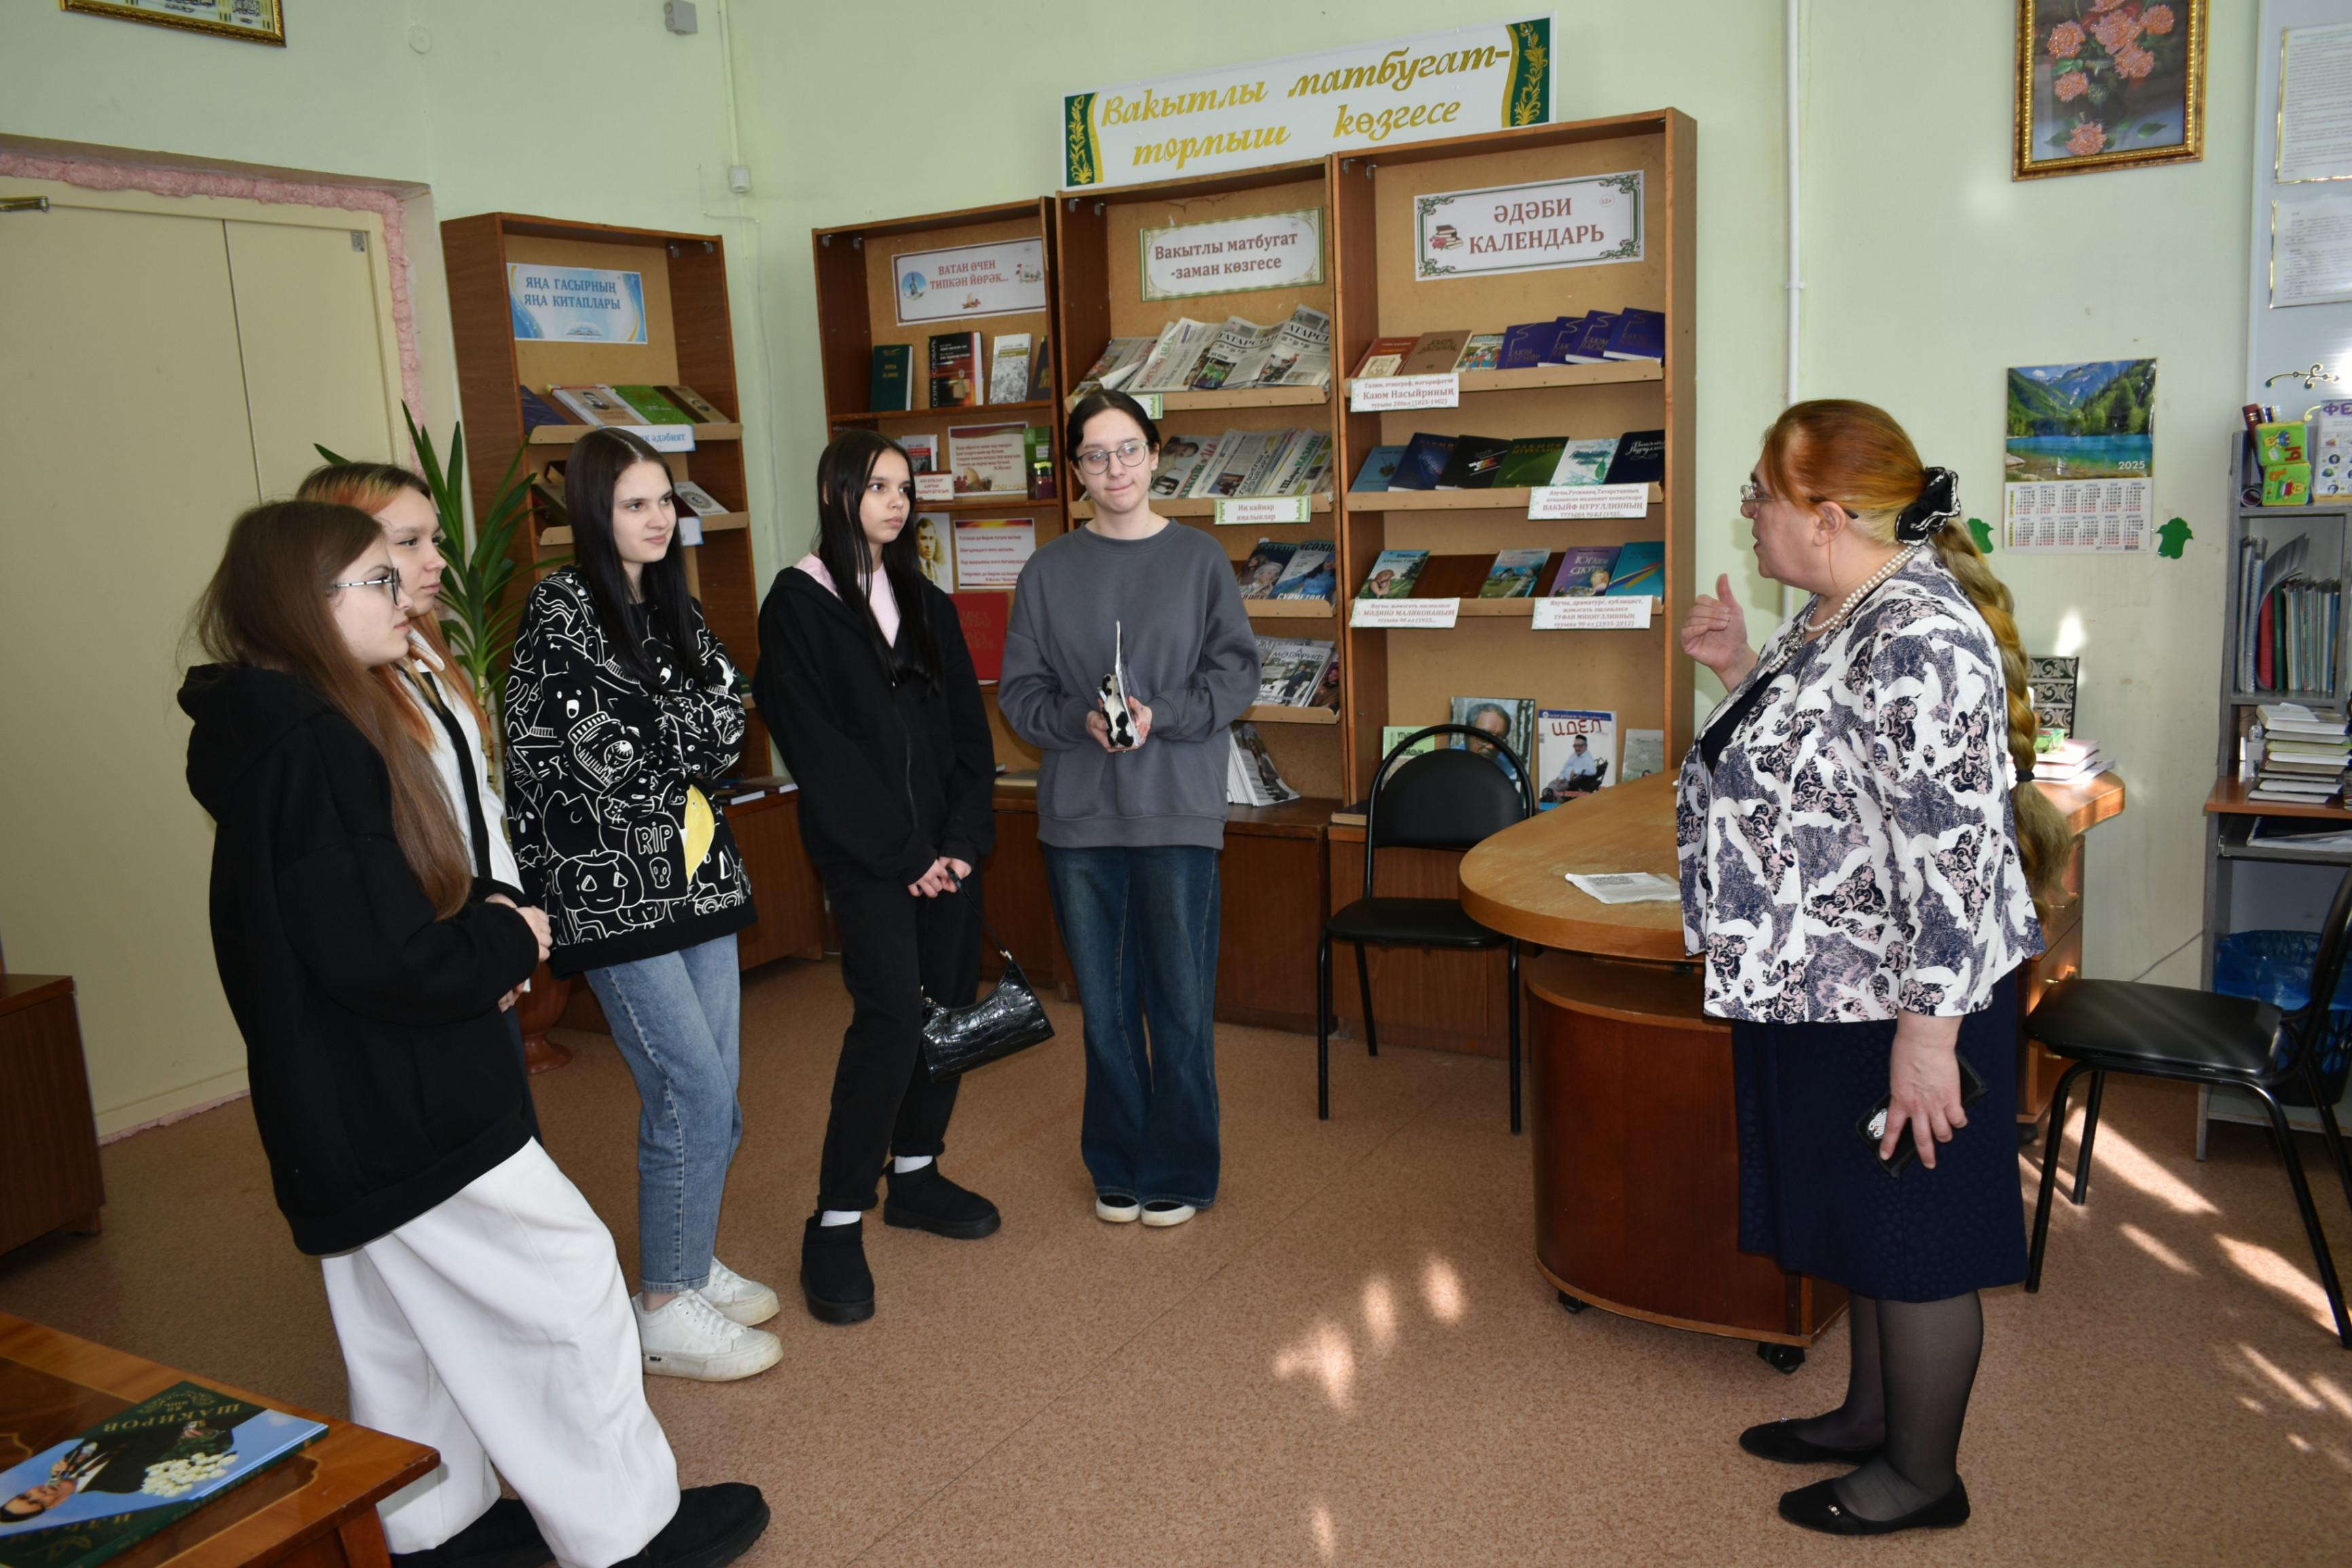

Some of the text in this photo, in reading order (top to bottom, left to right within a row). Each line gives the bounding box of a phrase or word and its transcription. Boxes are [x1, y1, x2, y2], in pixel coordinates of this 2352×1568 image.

[1101, 44, 1510, 127] Вакытлы матбугат-
[1132, 99, 1461, 170] тормыш көзгесе
[1494, 197, 1573, 225] ӘДӘБИ
[1155, 232, 1298, 261] Вакытлы матбугат
[1469, 224, 1605, 255] КАЛЕНДАРЬ
[937, 259, 996, 276] ВАТАН ӨЧЕН
[1170, 256, 1282, 280] -заман көзгесе
[525, 276, 617, 295] ЯҢА ГАСЫРНЫҢ
[929, 277, 969, 290] ТИПКӘН
[524, 294, 621, 310] ЯҢА КИТАПЛАРЫ
[1363, 388, 1455, 400] Каюм Насыйриның
[652, 432, 685, 443] әдәбият
[2118, 460, 2145, 470] 2025
[1238, 502, 1275, 512] Иң кайнар
[103, 1402, 242, 1434] ШАКИРОВ
